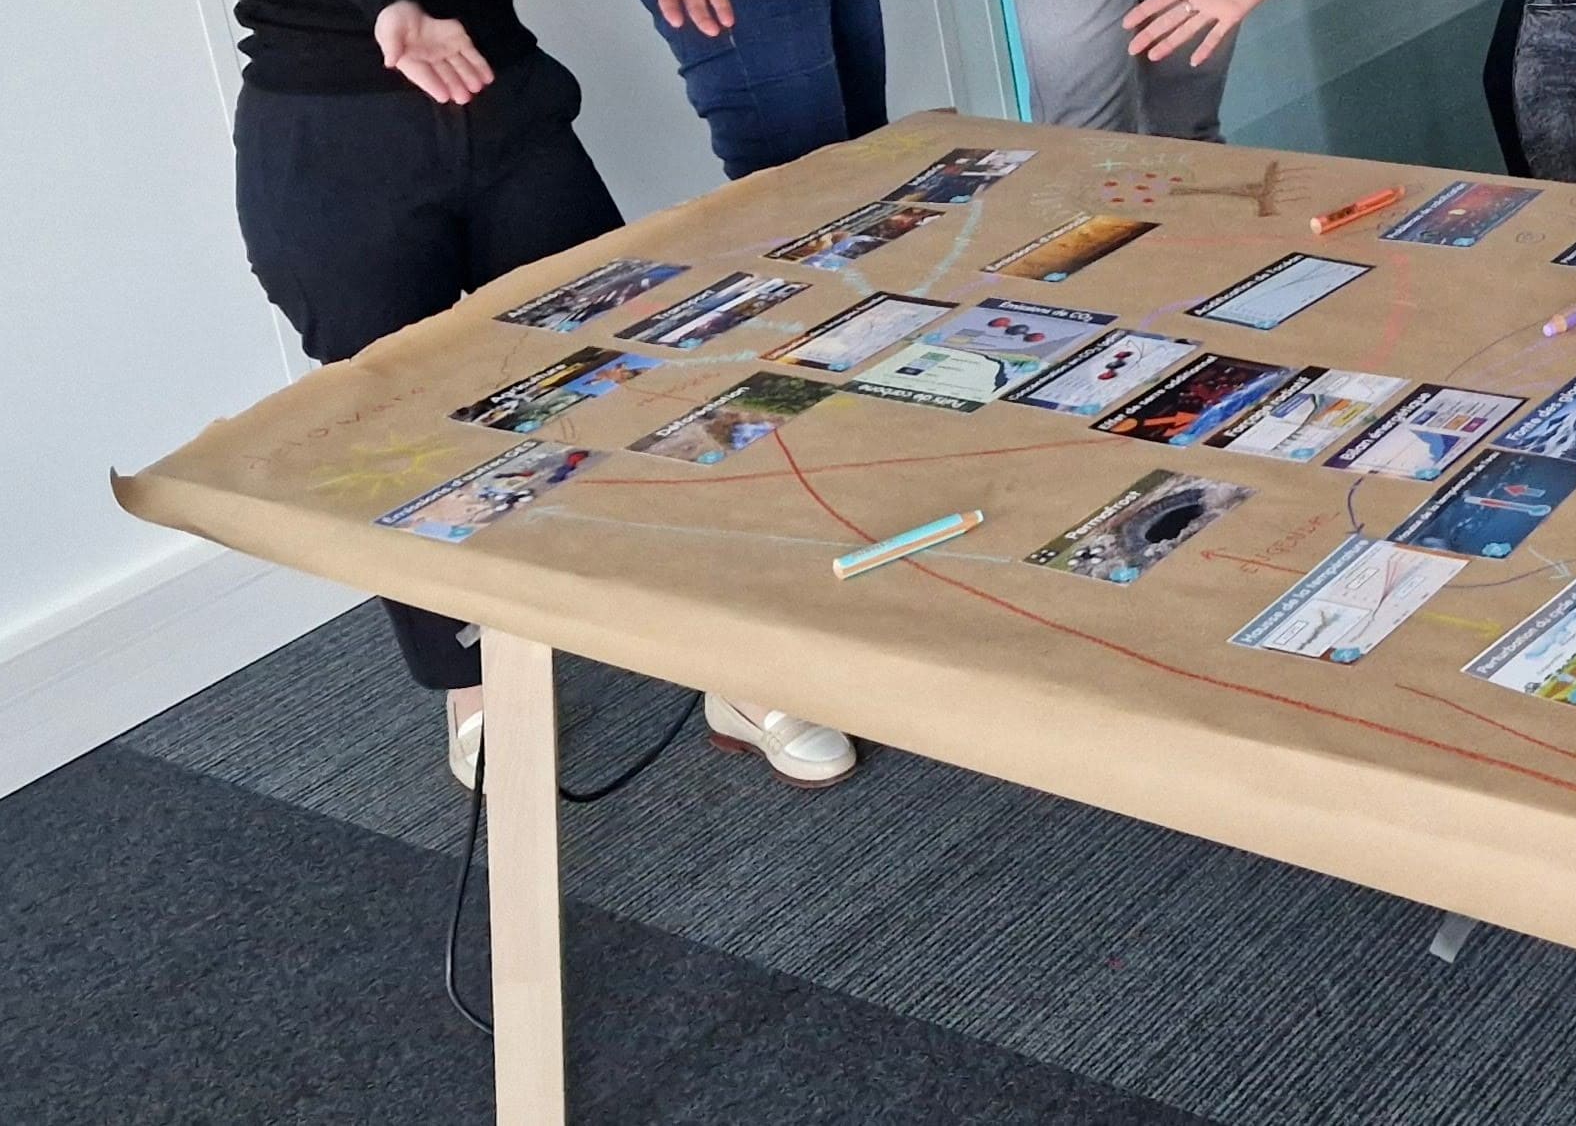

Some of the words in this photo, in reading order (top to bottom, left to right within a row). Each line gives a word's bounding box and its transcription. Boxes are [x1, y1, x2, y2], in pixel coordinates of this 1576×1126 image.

[652, 290, 715, 320] Transport
[1052, 309, 1068, 317] de
[491, 364, 572, 403] Agriculture
[858, 384, 912, 397] carbone
[913, 393, 933, 402] de
[1098, 414, 1126, 430] Effet
[1125, 405, 1141, 414] de
[1139, 389, 1165, 405] serre
[1165, 356, 1217, 389] additionnel
[1224, 405, 1278, 438] Forçage
[1269, 377, 1310, 405] radiatif
[656, 387, 749, 436] Déforestation
[1339, 439, 1374, 460] Bilan
[1369, 393, 1438, 439] énergétique
[1505, 418, 1542, 440] Fonte
[1538, 402, 1562, 418] des
[1065, 490, 1141, 541] Permafrost
[1240, 611, 1284, 643] Hausse
[1282, 599, 1299, 611] de
[1292, 588, 1311, 598] la
[1477, 628, 1537, 673] Perturbation
[1536, 617, 1551, 628] du
[1548, 599, 1574, 618] cycle
